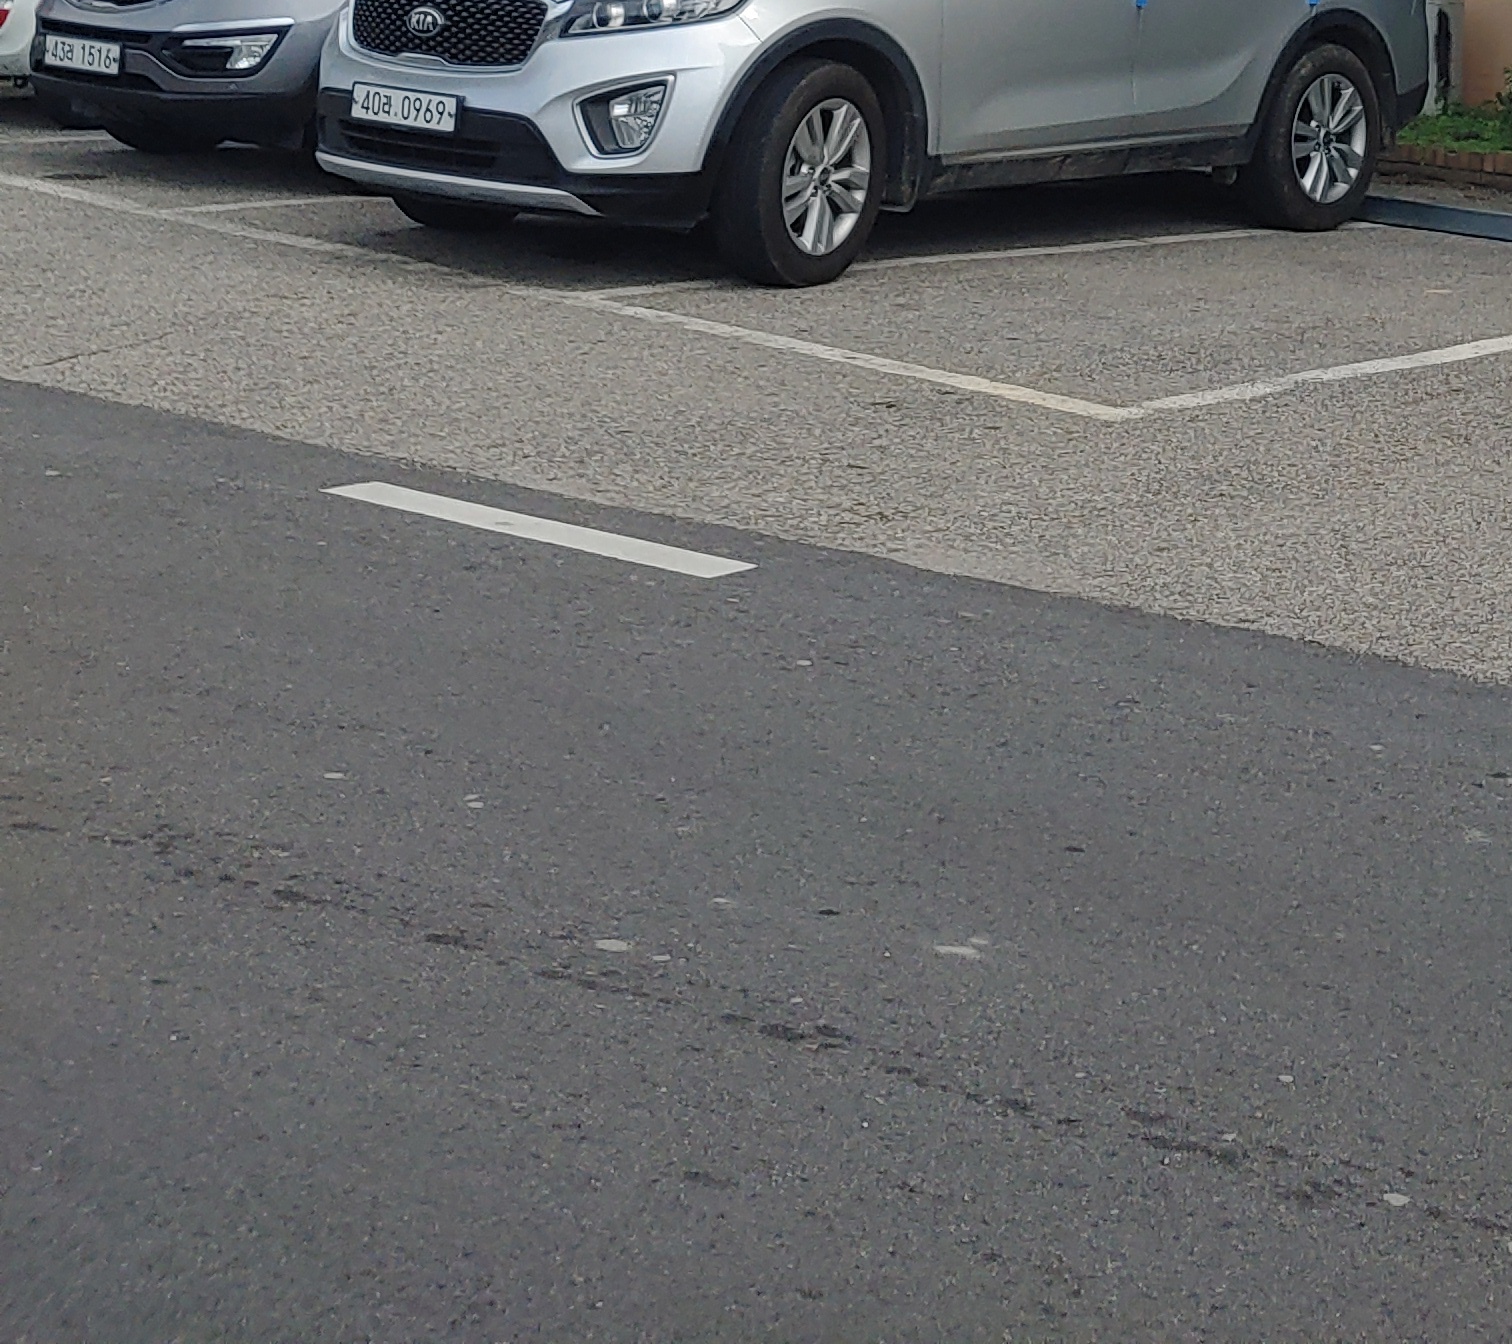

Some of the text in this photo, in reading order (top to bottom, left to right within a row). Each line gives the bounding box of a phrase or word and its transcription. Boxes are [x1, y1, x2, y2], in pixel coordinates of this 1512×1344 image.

[410, 13, 434, 31] KIA
[81, 43, 112, 69] 1516
[401, 95, 446, 126] 0969
